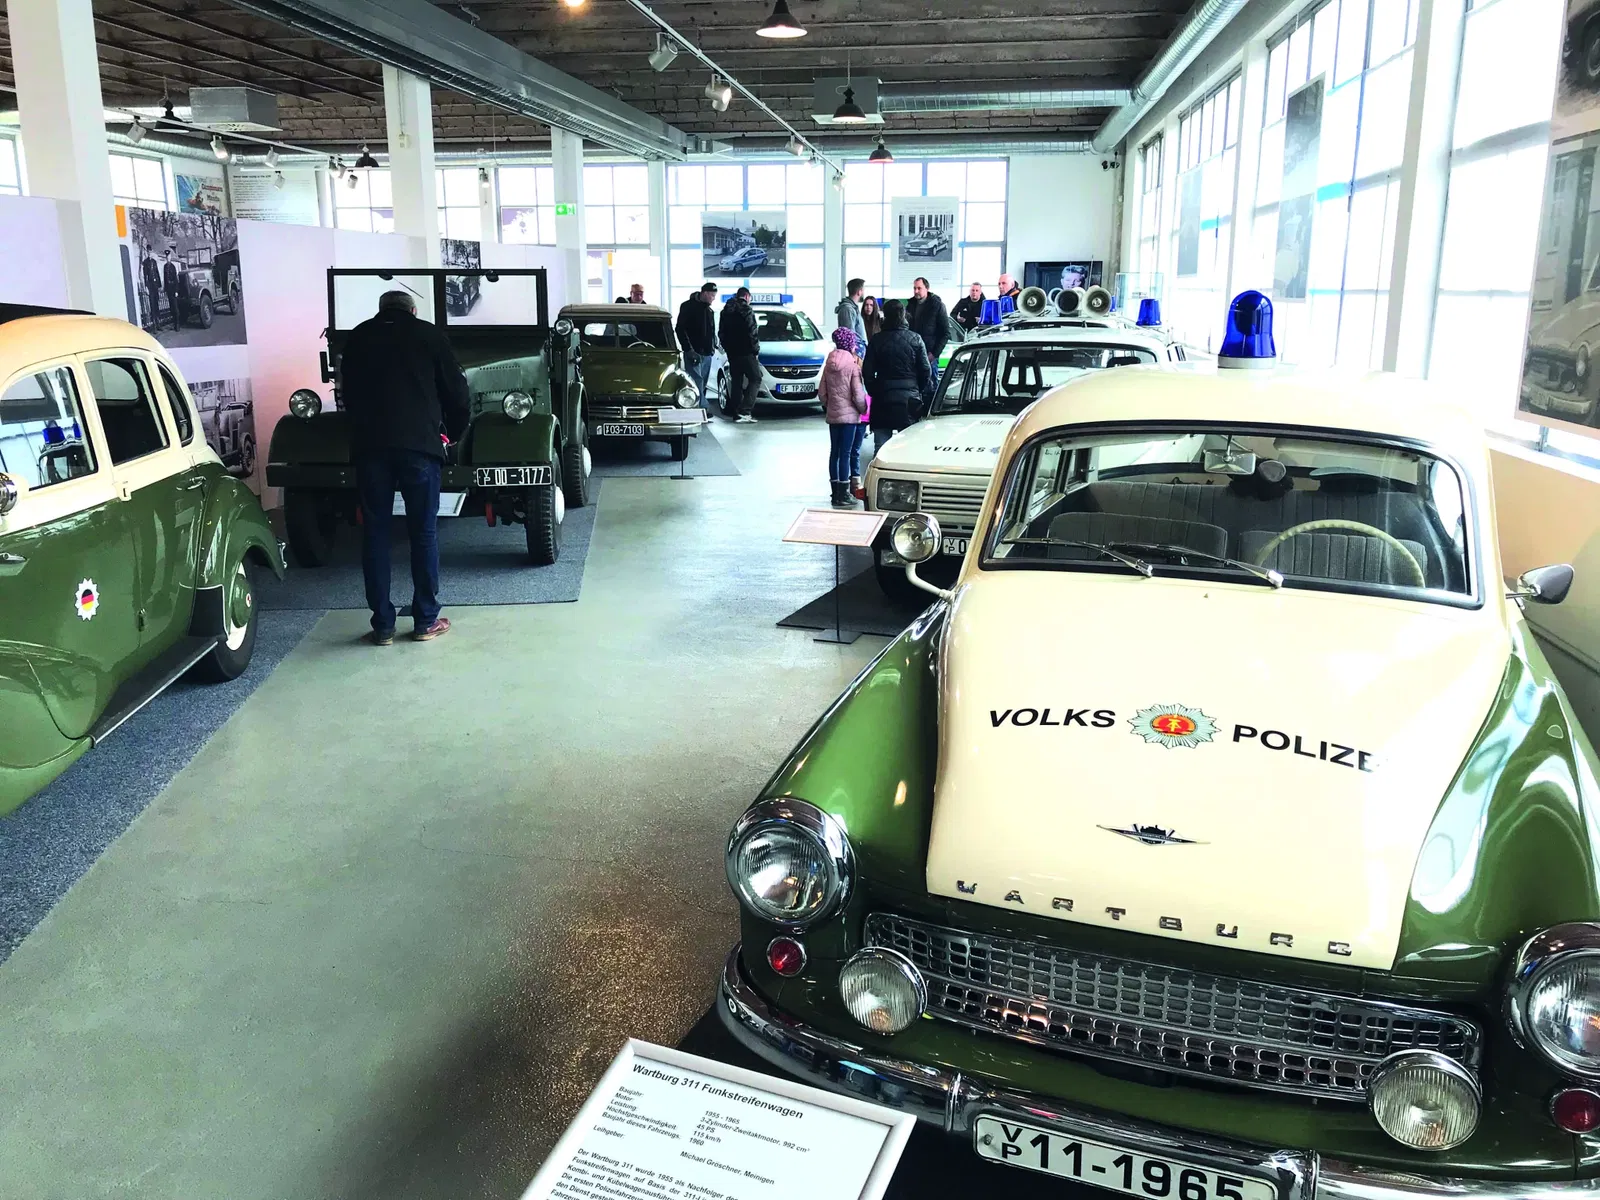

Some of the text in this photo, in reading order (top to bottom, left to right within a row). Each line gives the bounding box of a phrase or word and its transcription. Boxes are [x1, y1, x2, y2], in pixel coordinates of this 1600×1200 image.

[610, 425, 642, 434] 03-7103
[989, 707, 1117, 729] VOLKS
[1232, 724, 1376, 773] POLIZE
[955, 878, 1353, 957] WARTBURG
[632, 1063, 804, 1119] Wartburg 311 Funkstreifenwagen
[601, 1111, 626, 1123] Baujahr
[626, 1119, 647, 1129] dieses
[704, 1110, 720, 1119] 1955
[725, 1115, 741, 1125] 1965
[693, 1130, 722, 1143] 115 km/h
[705, 1126, 716, 1134] PS
[689, 1137, 705, 1146] 1960
[782, 1140, 796, 1150] 992
[566, 1163, 590, 1176] Kombi-
[591, 1171, 605, 1181] und
[571, 1156, 631, 1179] Funkstreifenwagen
[633, 1175, 646, 1183] auf
[647, 1179, 666, 1190] Basis
[668, 1186, 681, 1195] der
[577, 1147, 589, 1156] Der
[591, 1152, 620, 1167] Wartburg
[621, 1161, 634, 1170] 311
[635, 1166, 656, 1177] wurde
[657, 1173, 674, 1183] 1955
[674, 1179, 686, 1187] als
[686, 1182, 724, 1198] Nachfolger
[680, 1150, 706, 1164] Michael
[743, 1170, 775, 1185] Meinigen
[1029, 1133, 1244, 1200] 11-1965
[555, 1180, 569, 1189] den
[568, 1184, 591, 1196] Dienst
[561, 1171, 573, 1180] Die
[573, 1176, 594, 1187] ersten
